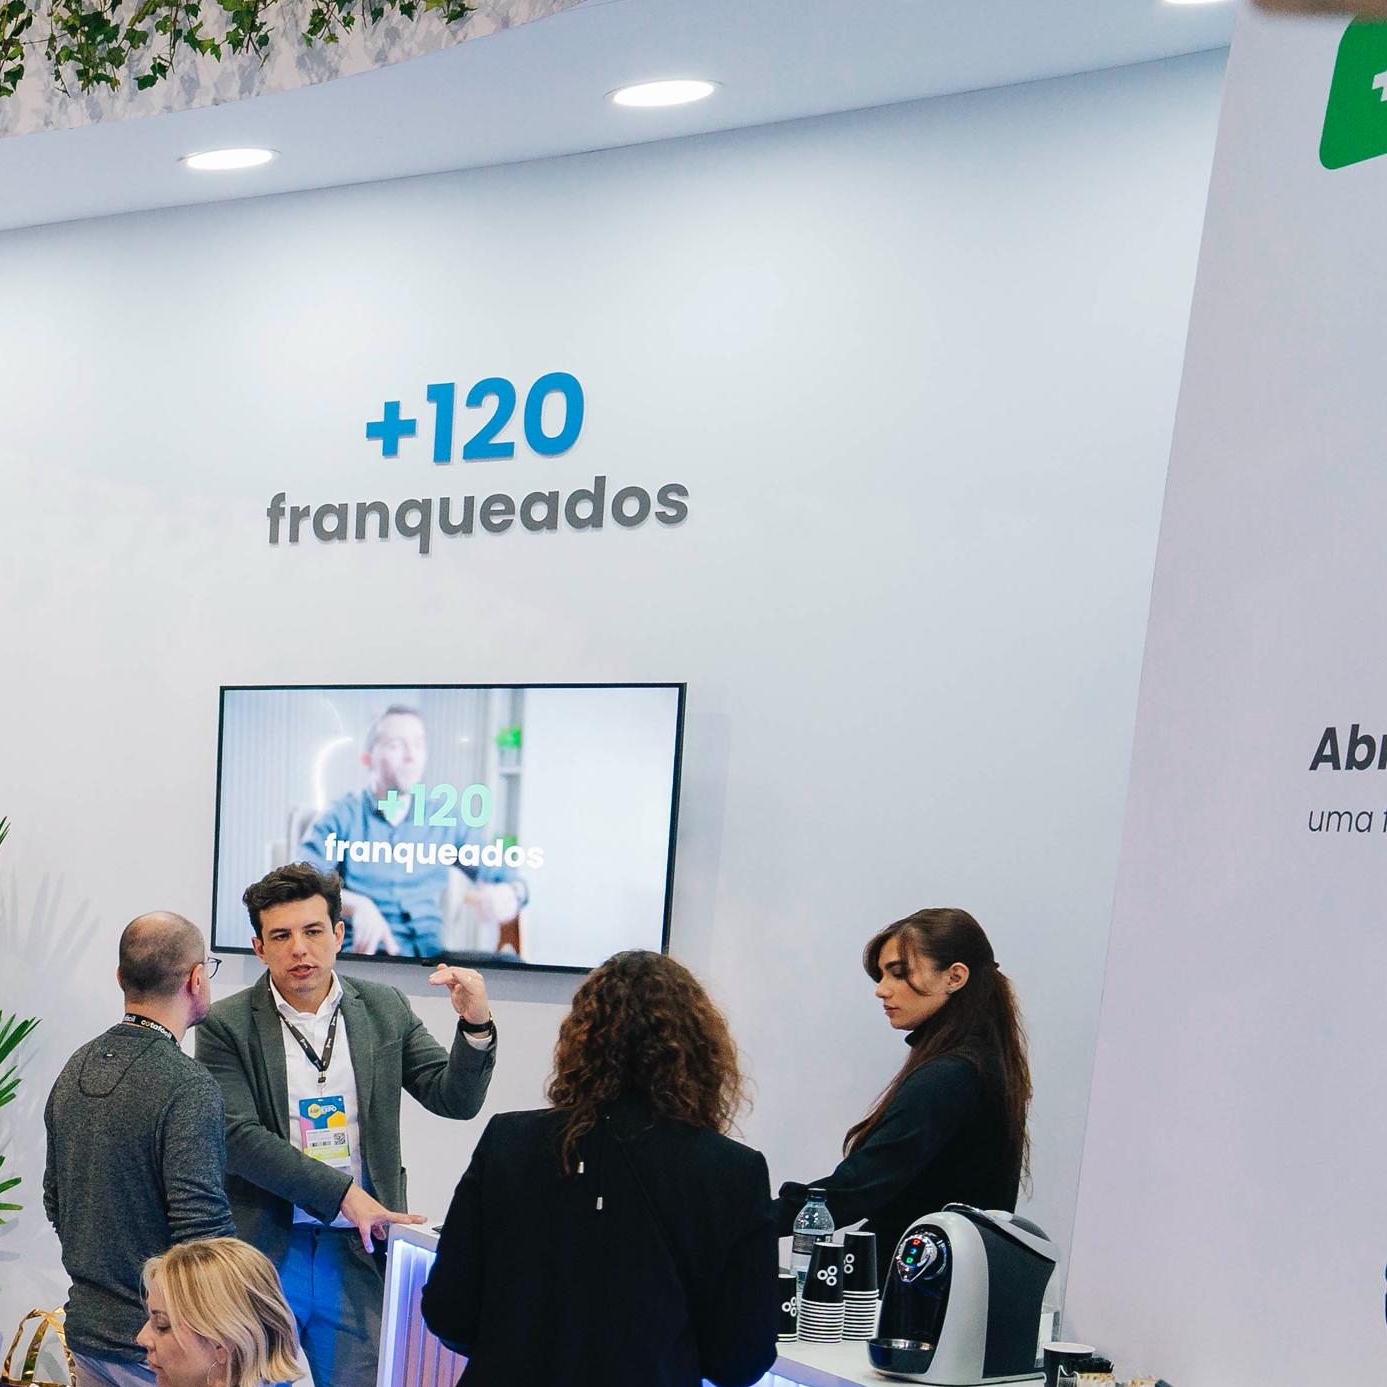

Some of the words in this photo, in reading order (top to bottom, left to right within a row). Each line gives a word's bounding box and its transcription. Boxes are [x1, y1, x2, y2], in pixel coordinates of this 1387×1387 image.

[366, 371, 584, 464] +120
[266, 475, 689, 554] franqueados
[377, 783, 493, 828] +120
[1309, 810, 1373, 833] uma
[325, 833, 545, 873] franqueados
